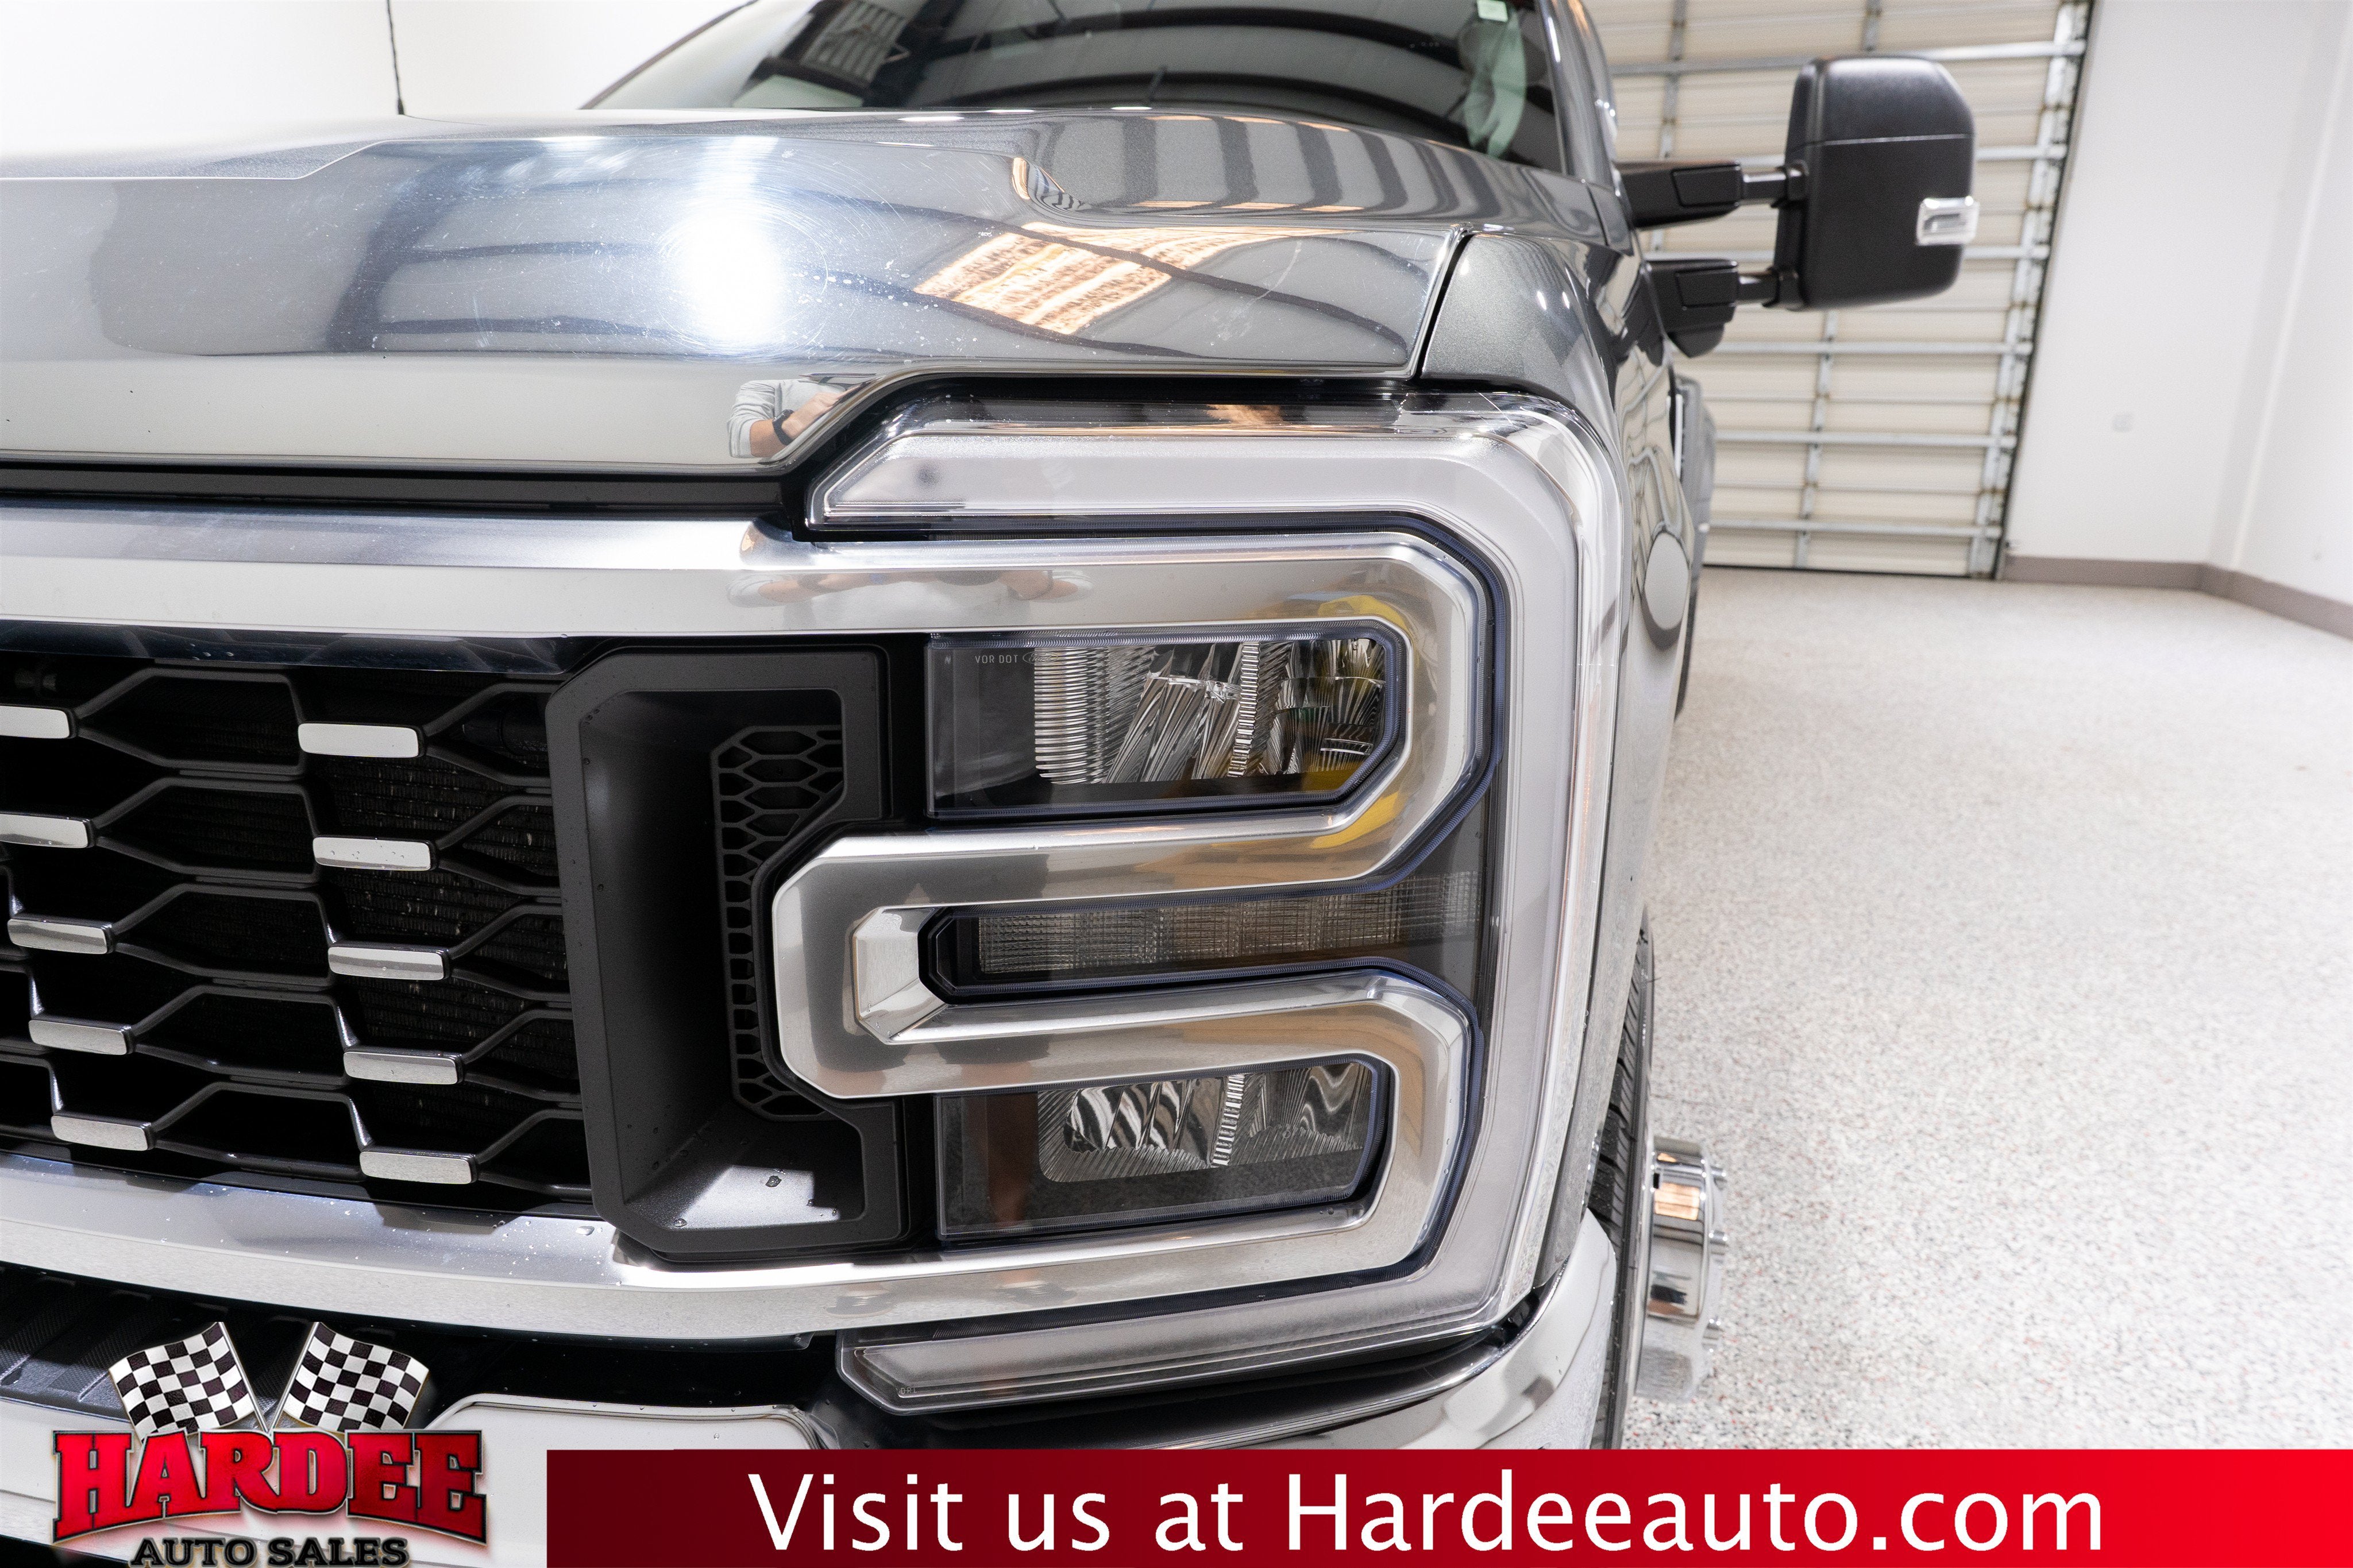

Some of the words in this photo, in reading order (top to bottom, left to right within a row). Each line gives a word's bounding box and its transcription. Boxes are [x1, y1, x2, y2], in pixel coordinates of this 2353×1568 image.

[975, 655, 994, 664] VOR
[999, 654, 1019, 663] DOT
[1027, 652, 1055, 663] Ford
[900, 1387, 917, 1395] DRL
